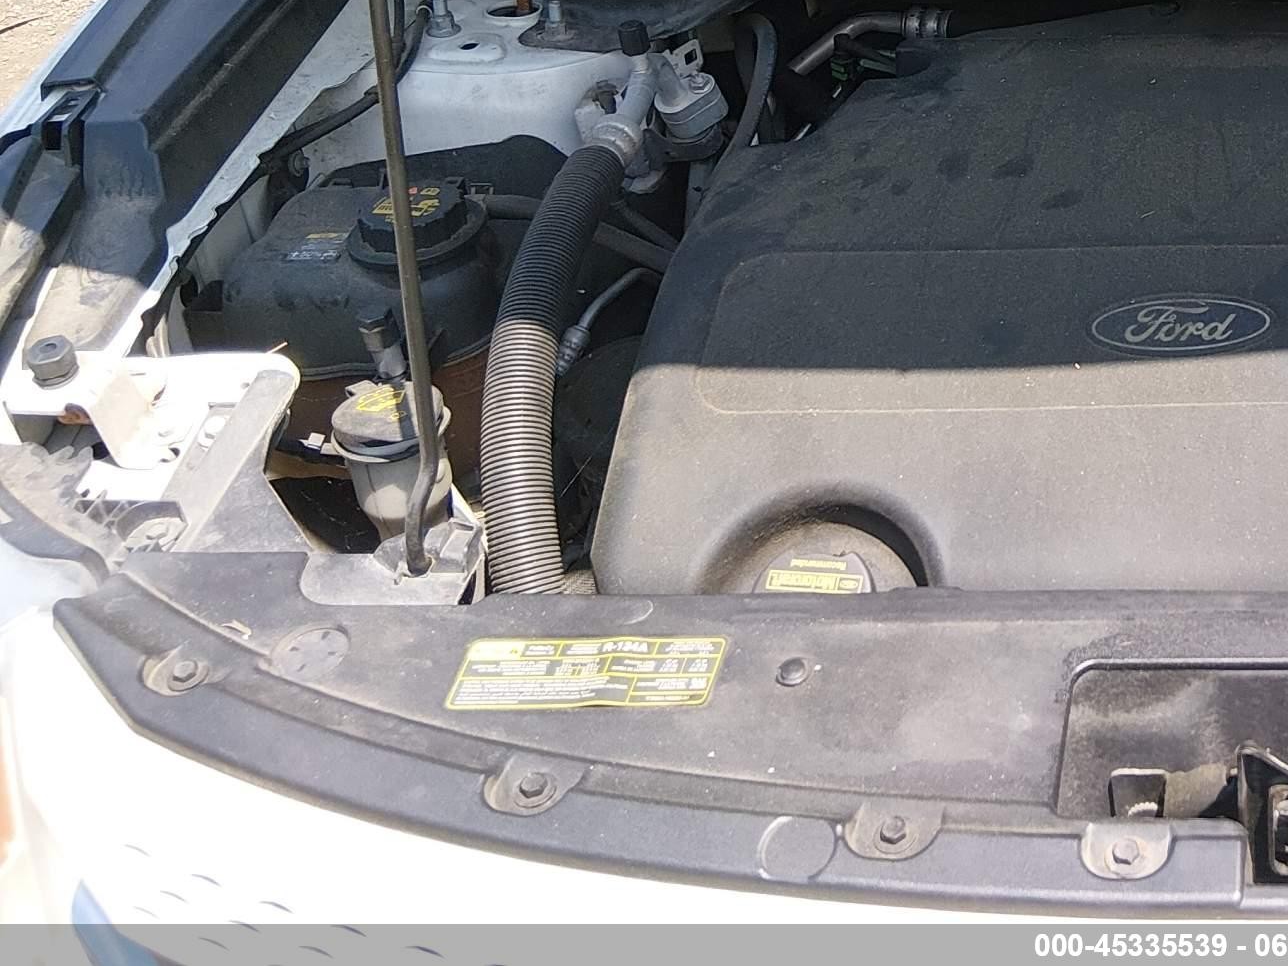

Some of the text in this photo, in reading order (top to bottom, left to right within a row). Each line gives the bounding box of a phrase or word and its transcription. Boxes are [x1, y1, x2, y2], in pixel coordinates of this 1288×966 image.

[1124, 301, 1237, 343] Ford
[790, 558, 847, 571] Recommended
[770, 573, 837, 590] Motorcraft
